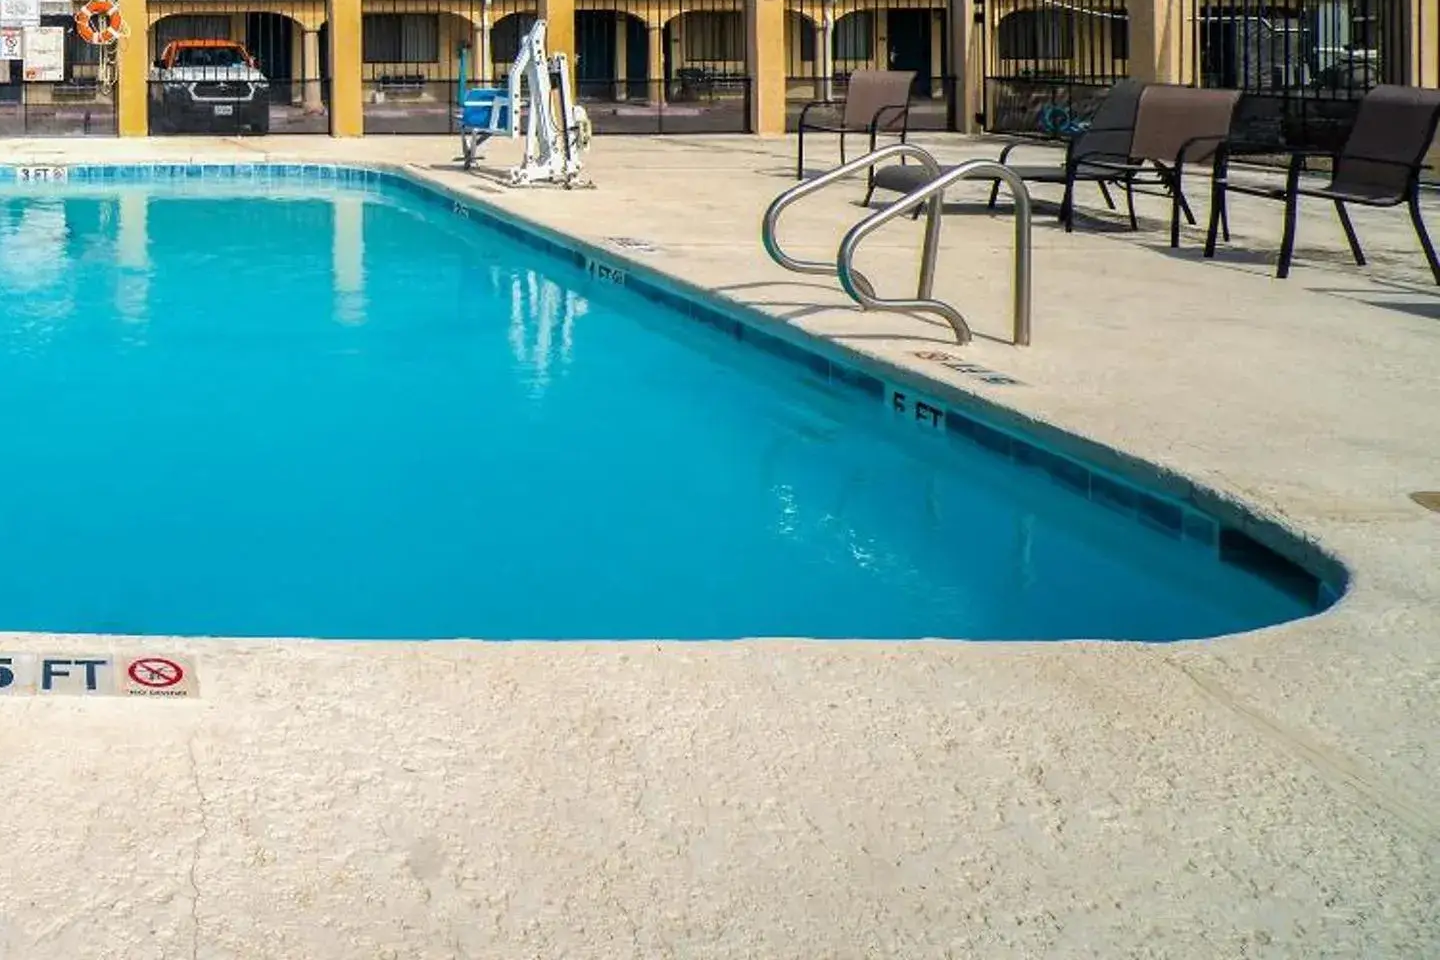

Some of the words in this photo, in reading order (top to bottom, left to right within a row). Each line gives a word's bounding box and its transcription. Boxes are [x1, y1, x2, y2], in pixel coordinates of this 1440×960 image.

[20, 168, 30, 181] 3
[34, 168, 50, 182] FT
[915, 401, 944, 428] FT
[42, 659, 109, 690] FT
